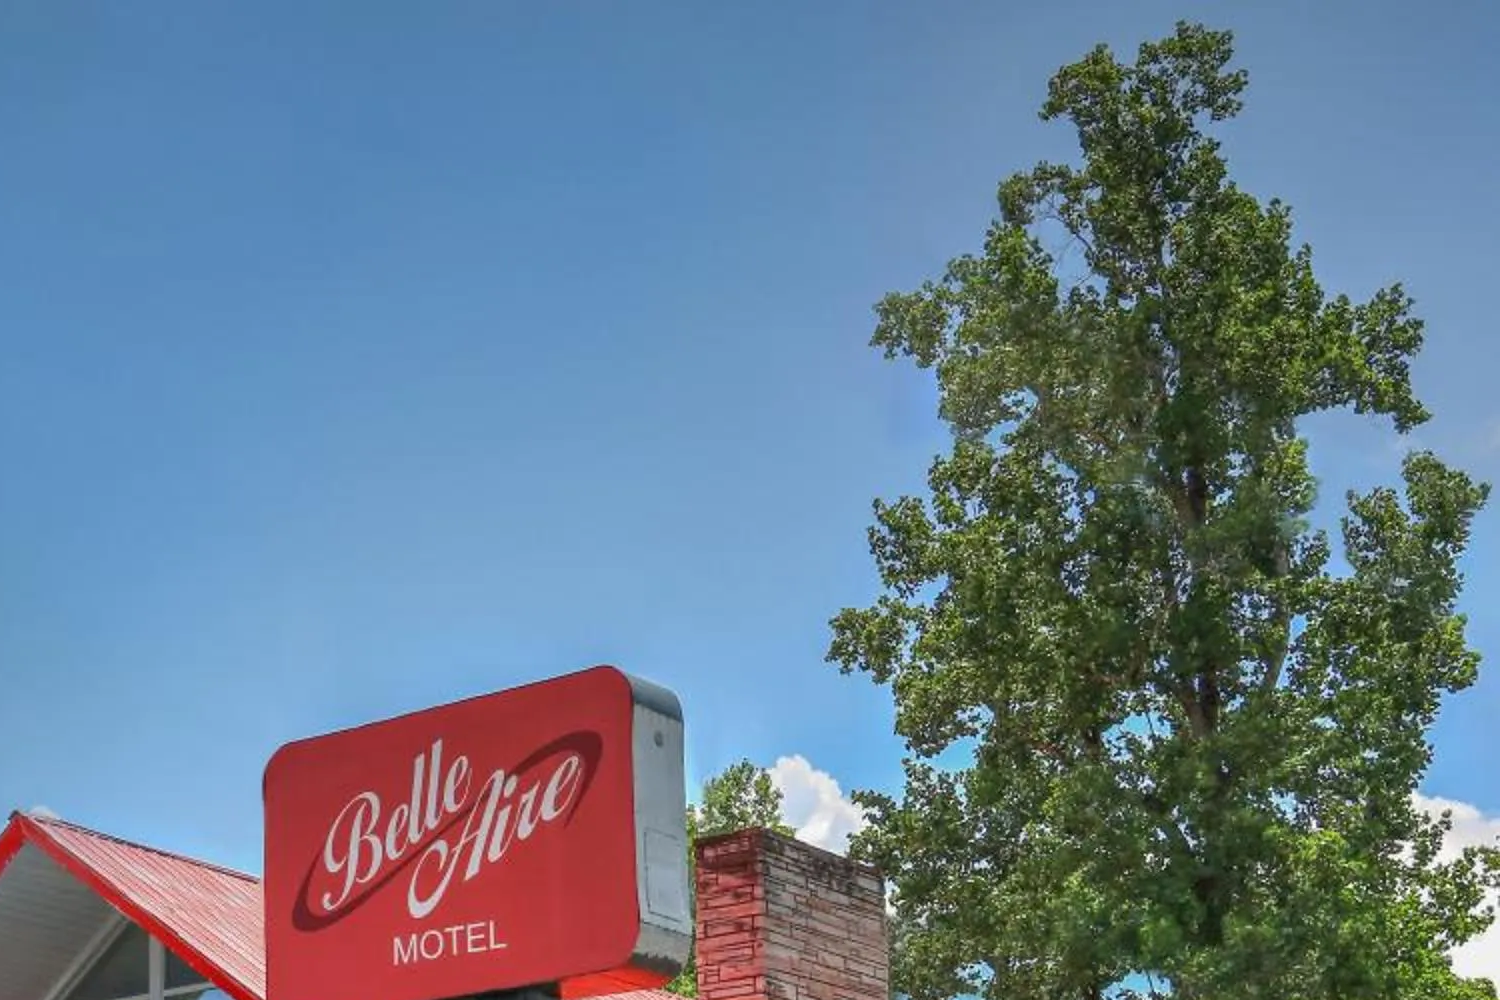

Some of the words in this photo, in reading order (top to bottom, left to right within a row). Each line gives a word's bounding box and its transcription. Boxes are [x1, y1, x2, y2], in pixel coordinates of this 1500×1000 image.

[323, 738, 472, 911] Belle
[407, 753, 584, 919] Aire
[392, 920, 507, 966] MOTEL
